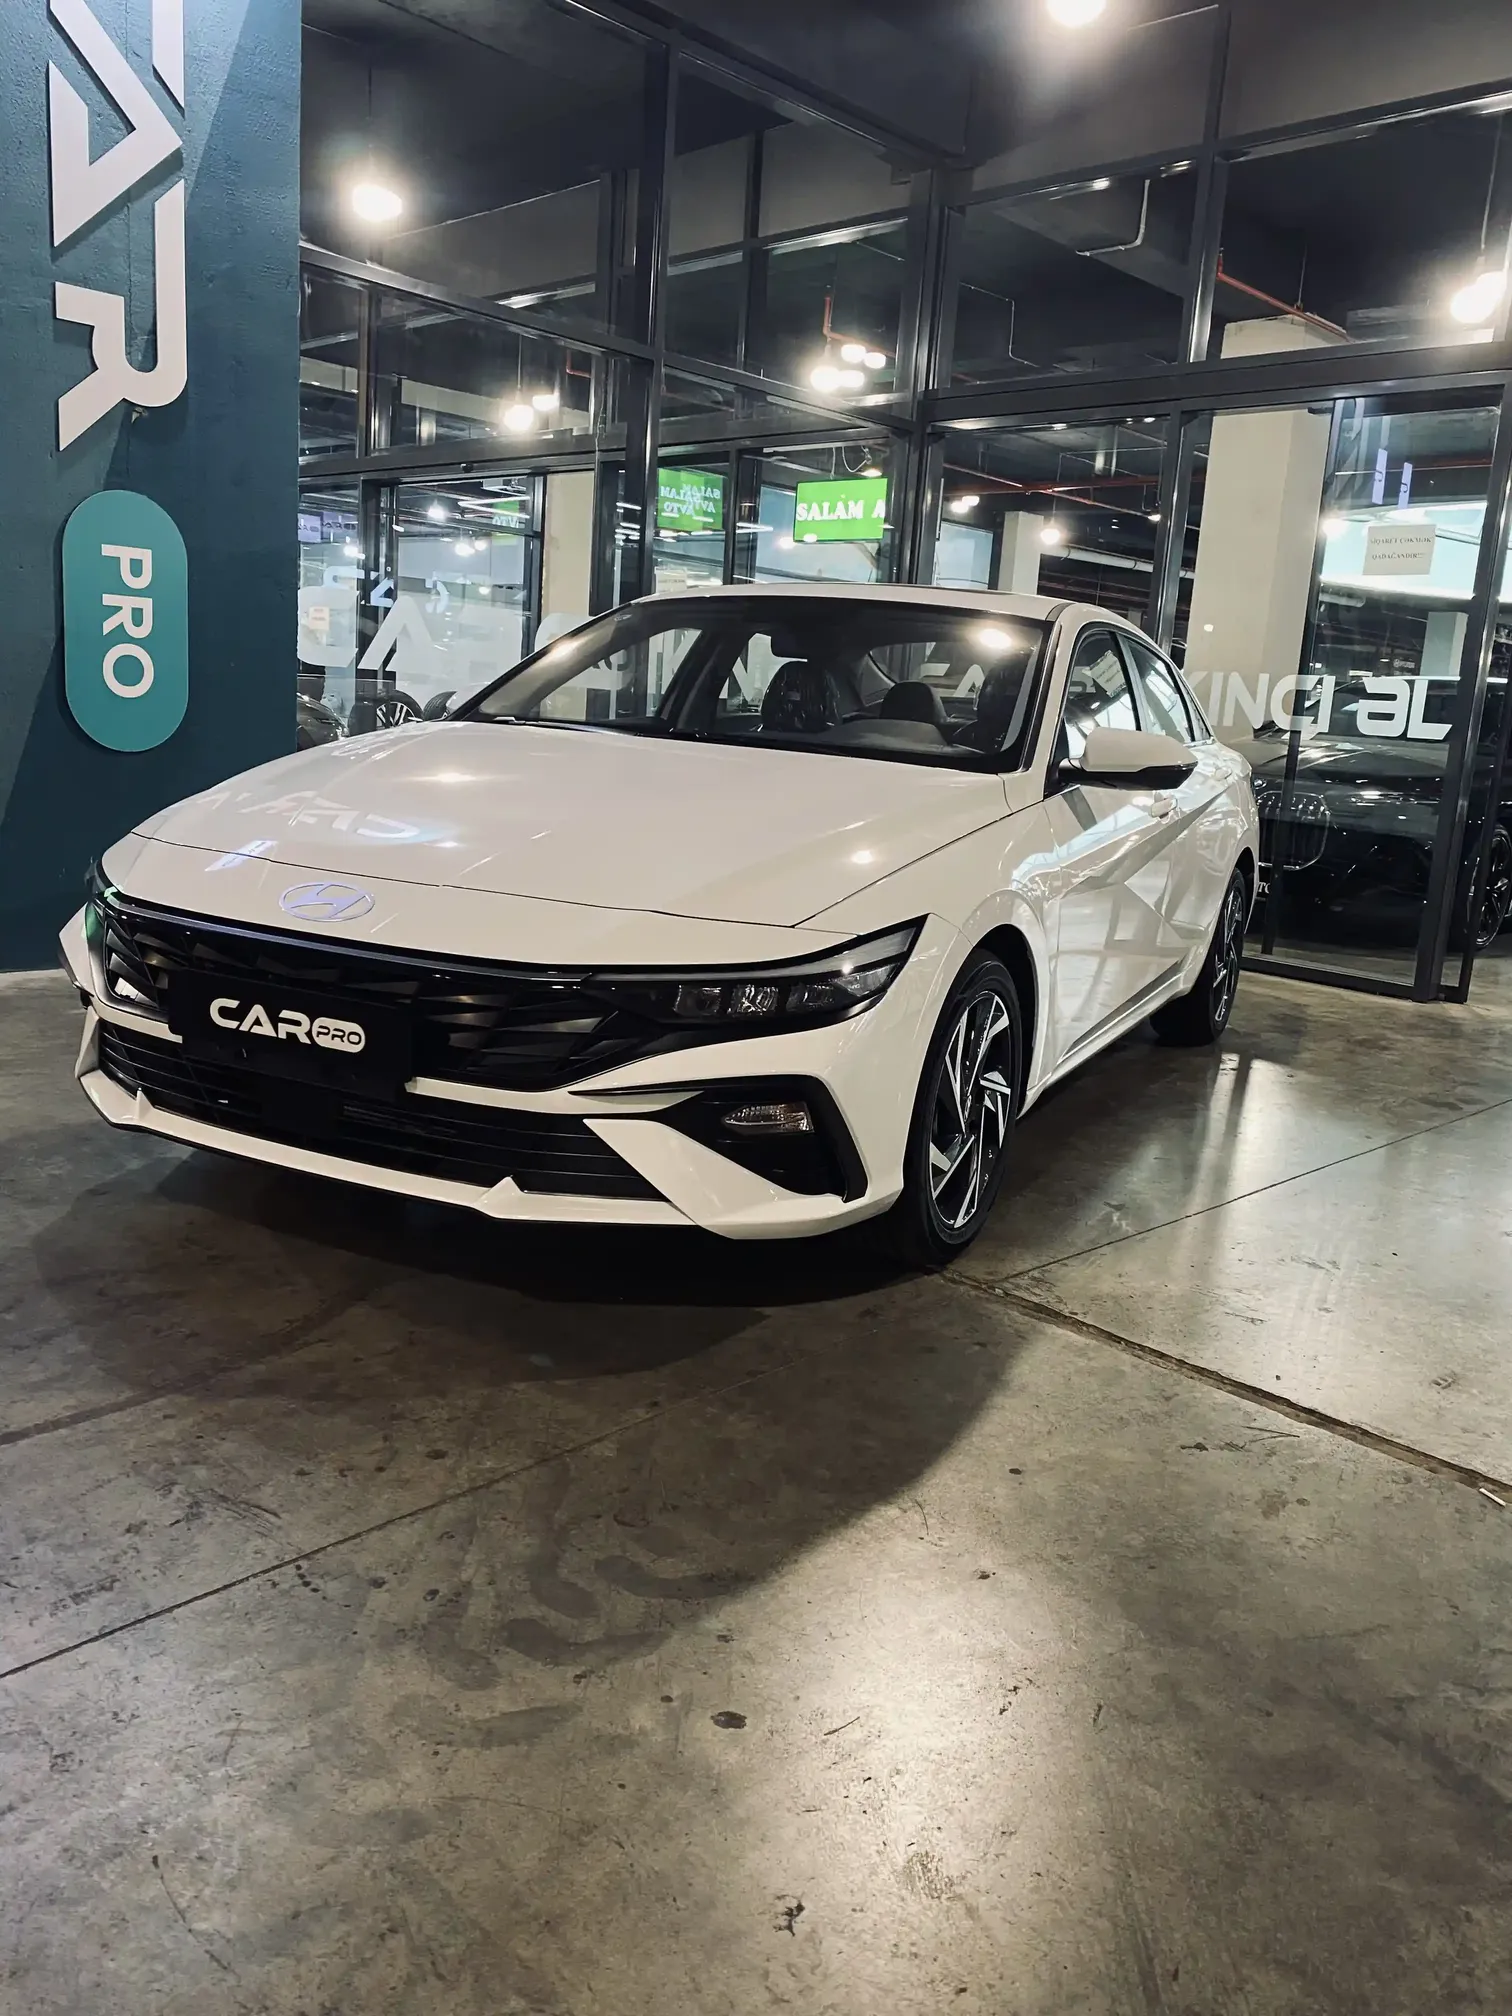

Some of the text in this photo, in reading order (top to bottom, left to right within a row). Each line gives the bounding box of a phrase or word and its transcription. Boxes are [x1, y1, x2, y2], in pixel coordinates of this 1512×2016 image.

[48, 0, 188, 699] AR PRO
[209, 997, 362, 1046] CAR PRO
